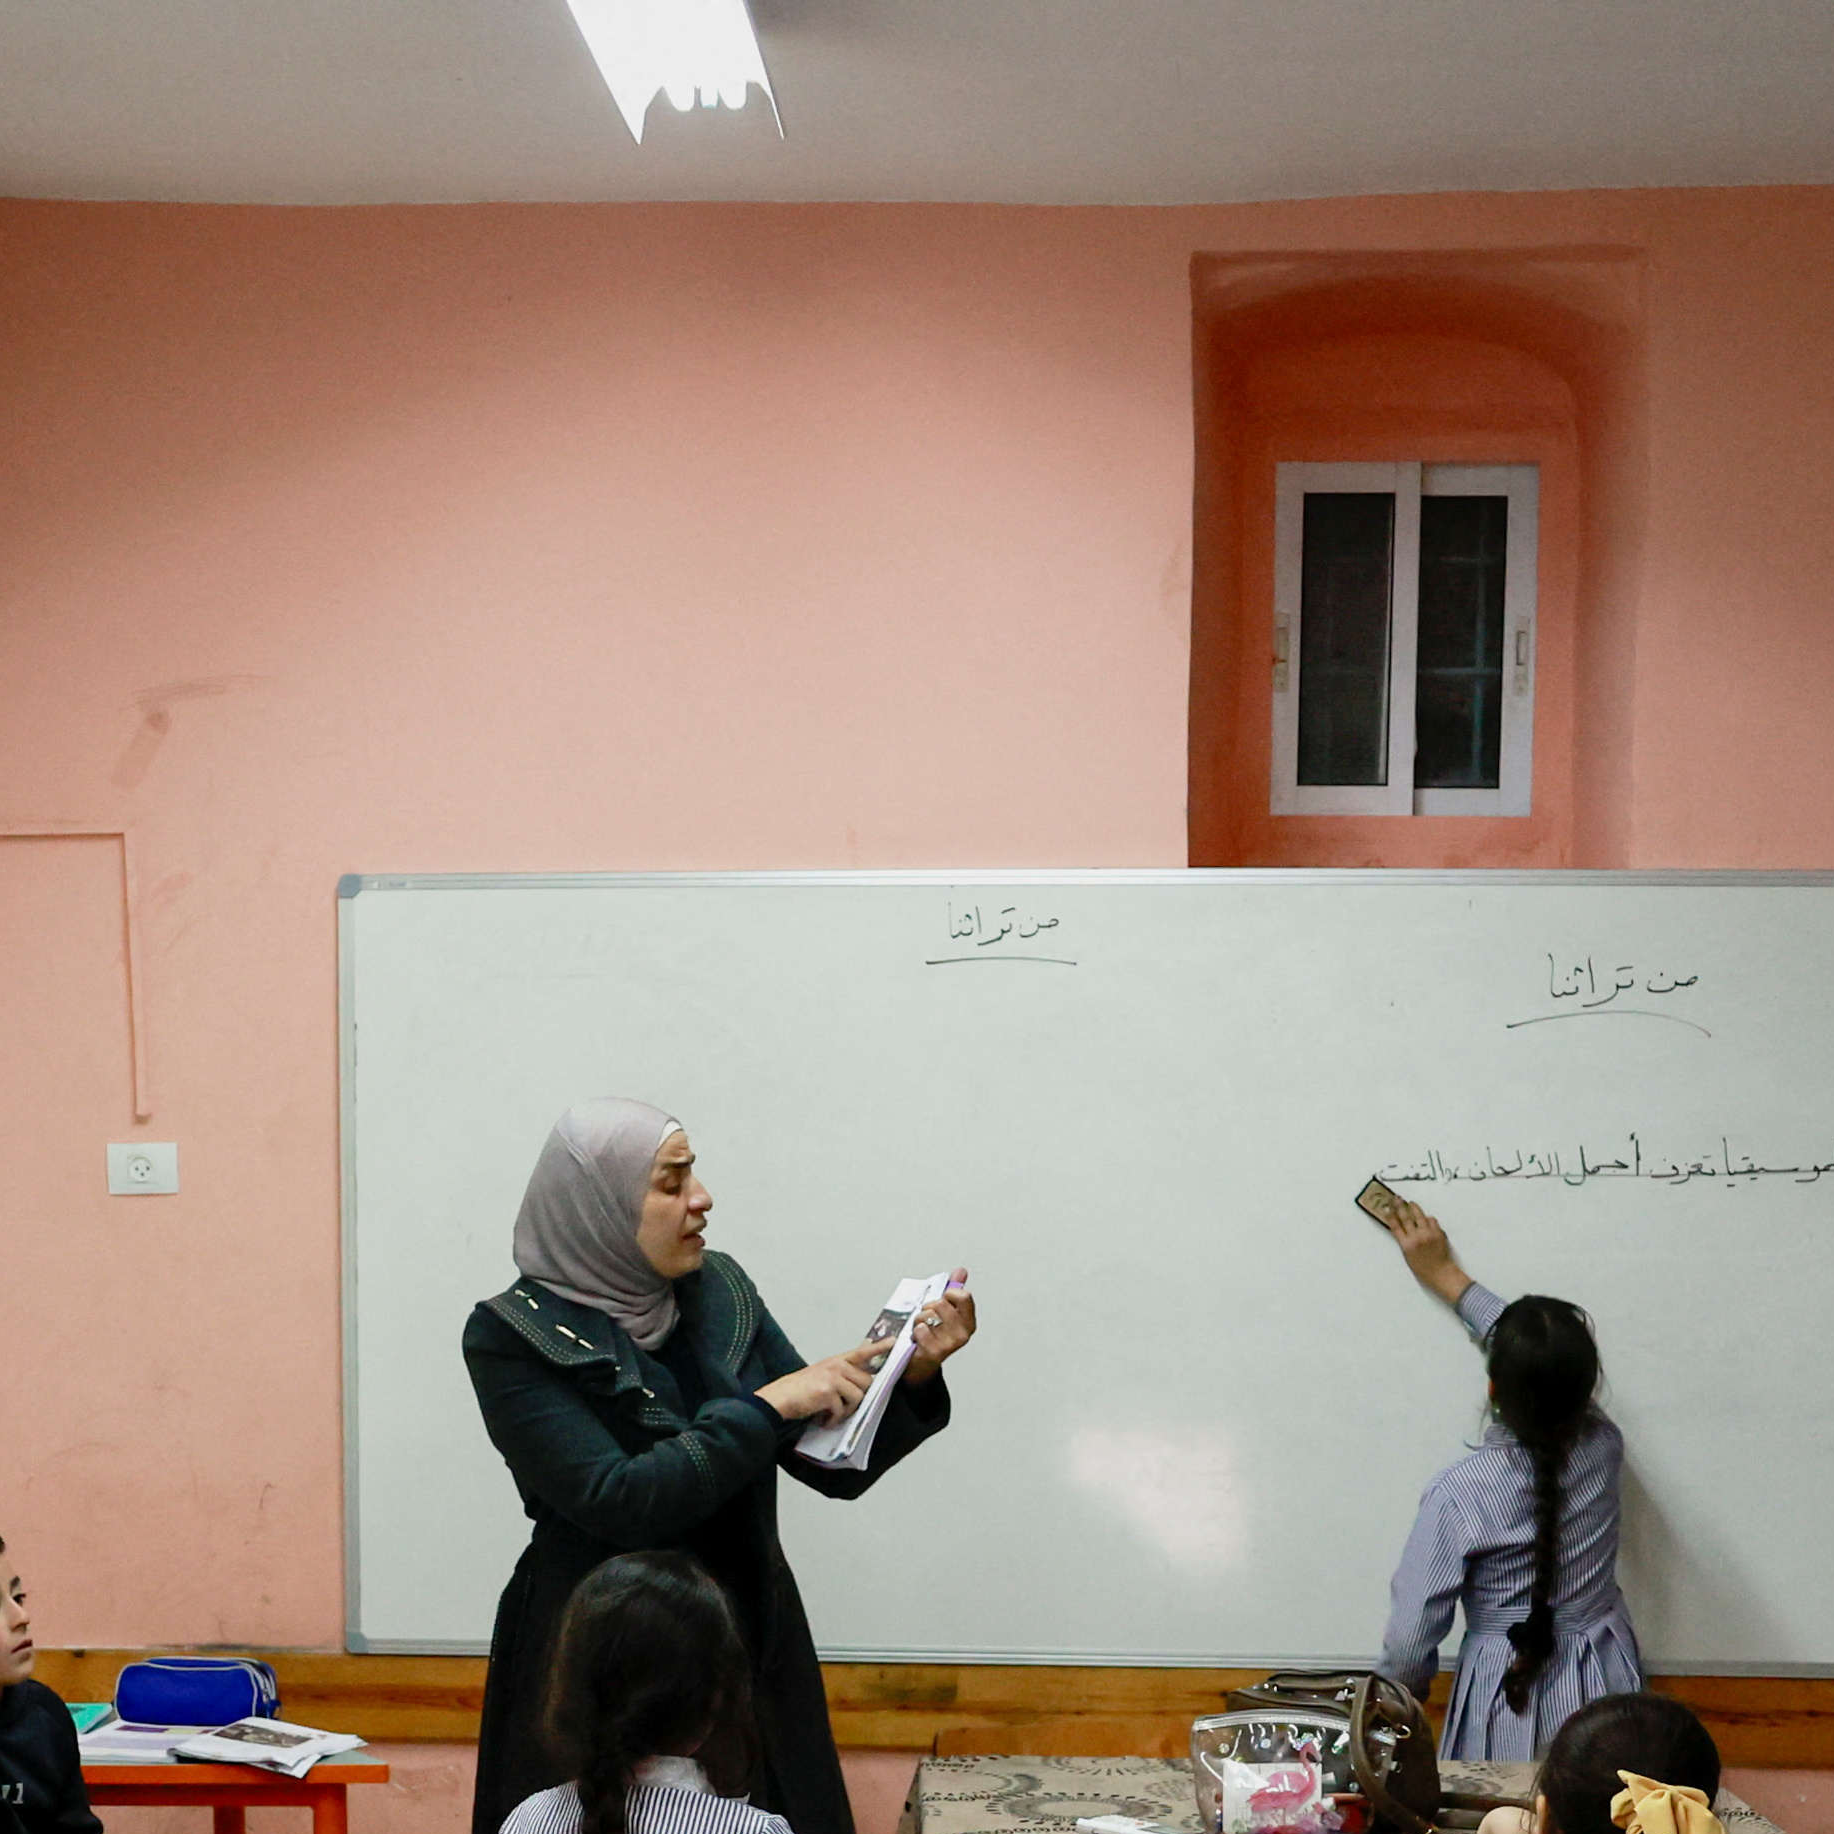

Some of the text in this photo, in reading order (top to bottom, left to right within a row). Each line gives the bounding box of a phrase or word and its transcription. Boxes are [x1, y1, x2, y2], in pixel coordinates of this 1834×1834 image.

[947, 900, 1060, 946] من تراثنا
[1546, 952, 1700, 1008] من تراثنا
[1563, 1131, 1641, 1186] أجمل
